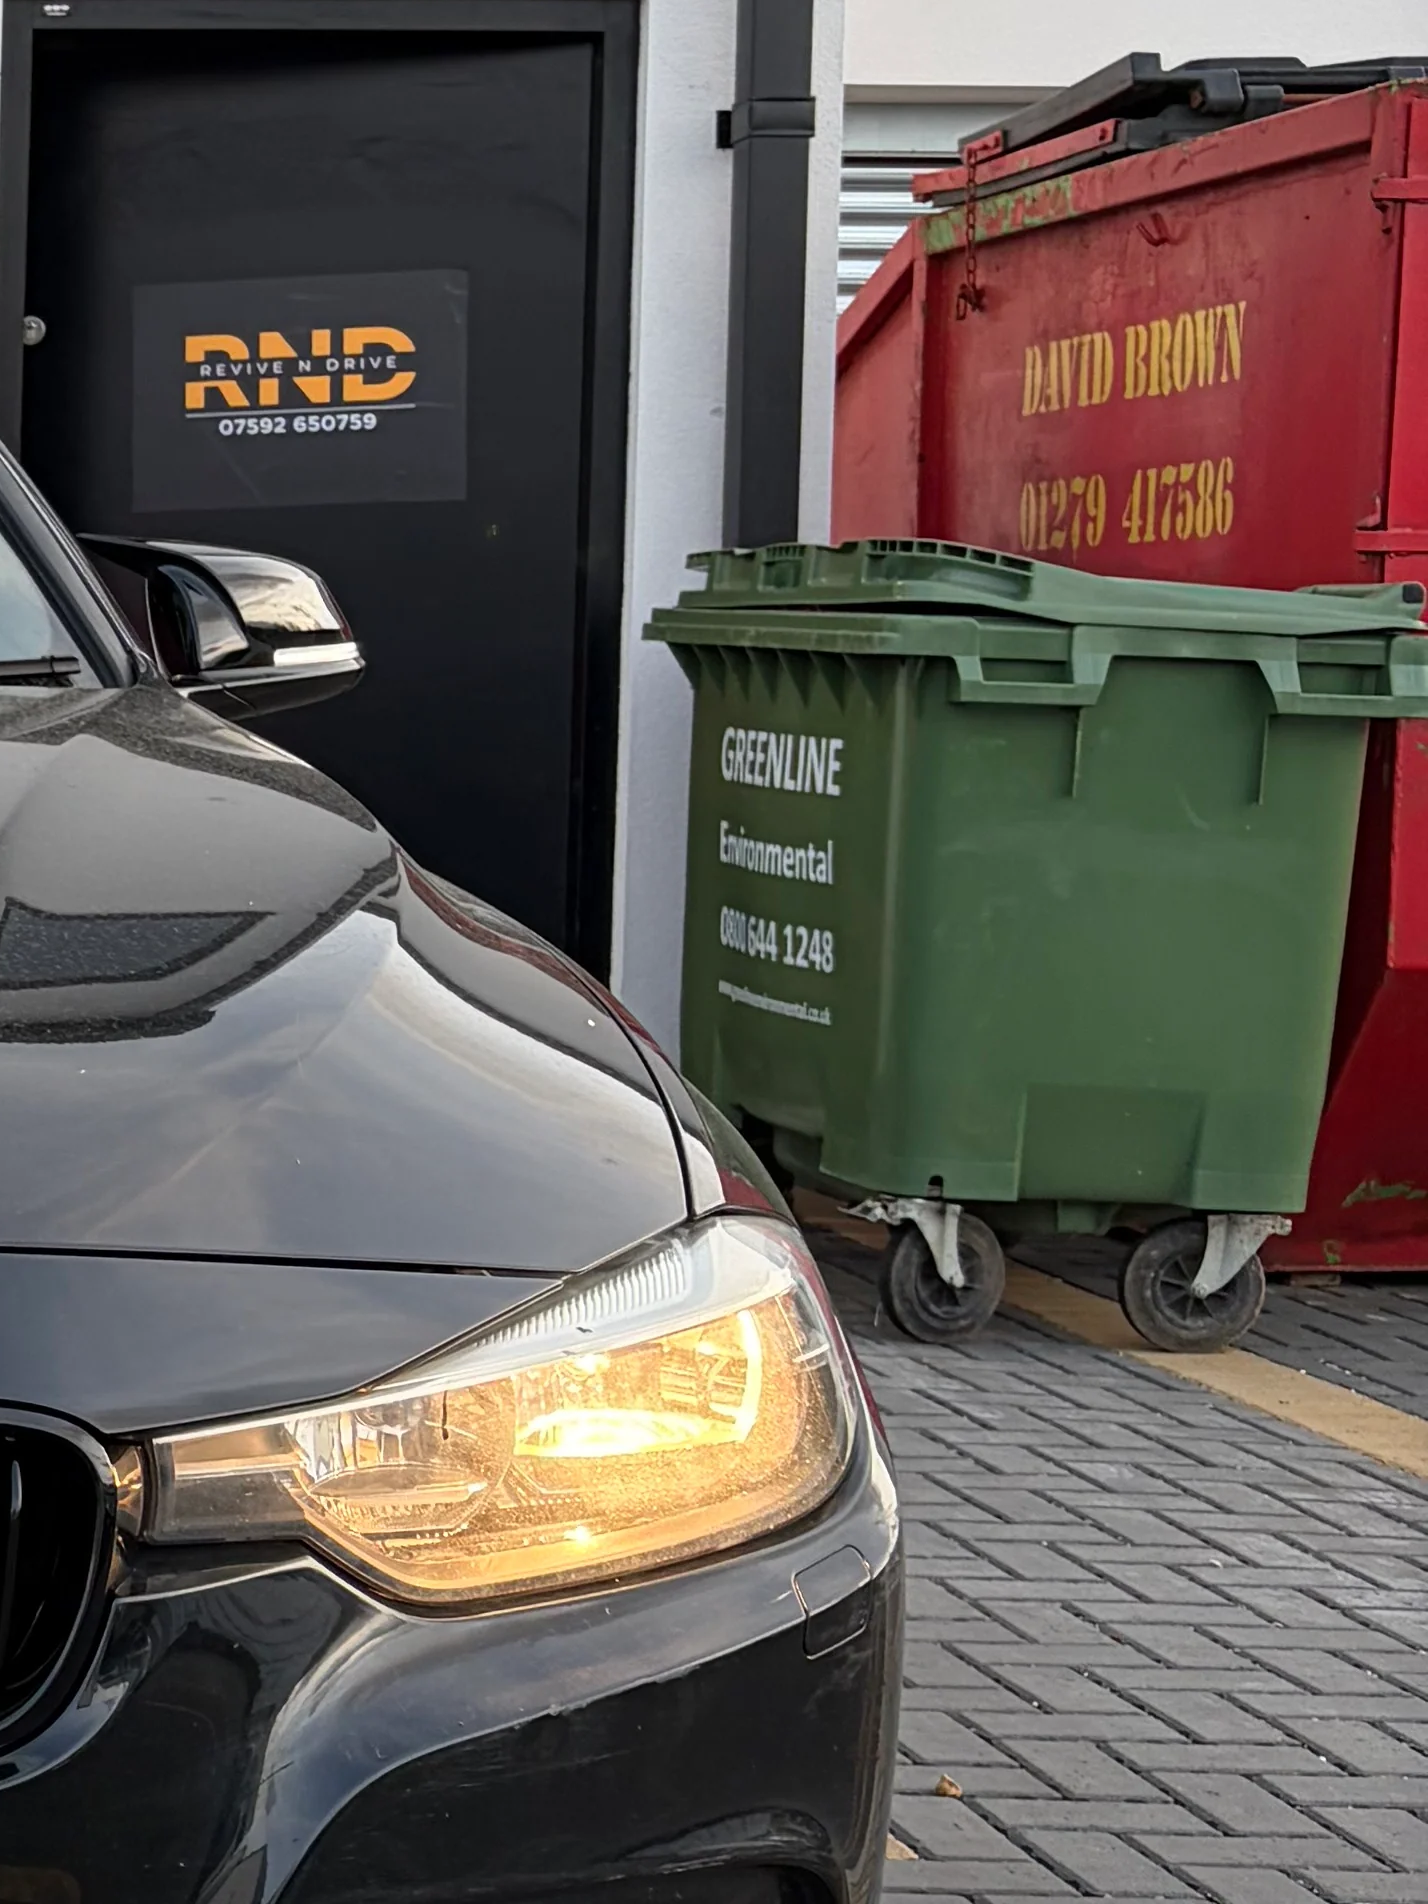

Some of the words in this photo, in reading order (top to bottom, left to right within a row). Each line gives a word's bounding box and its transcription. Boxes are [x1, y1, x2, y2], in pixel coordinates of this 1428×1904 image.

[185, 326, 416, 409] RND
[200, 361, 284, 377] REVIVE
[299, 360, 311, 372] N
[326, 355, 397, 372] DRIVE
[1022, 331, 1114, 416] DAVID
[1124, 301, 1246, 399] BROWN
[218, 416, 287, 436] 07592
[293, 413, 377, 433] 650759
[1020, 474, 1106, 554] 01279
[1122, 457, 1233, 544] 417586
[721, 726, 844, 796] GREENLINE
[720, 819, 834, 885] Environmental
[747, 915, 778, 962] 644
[783, 923, 835, 974] 1248
